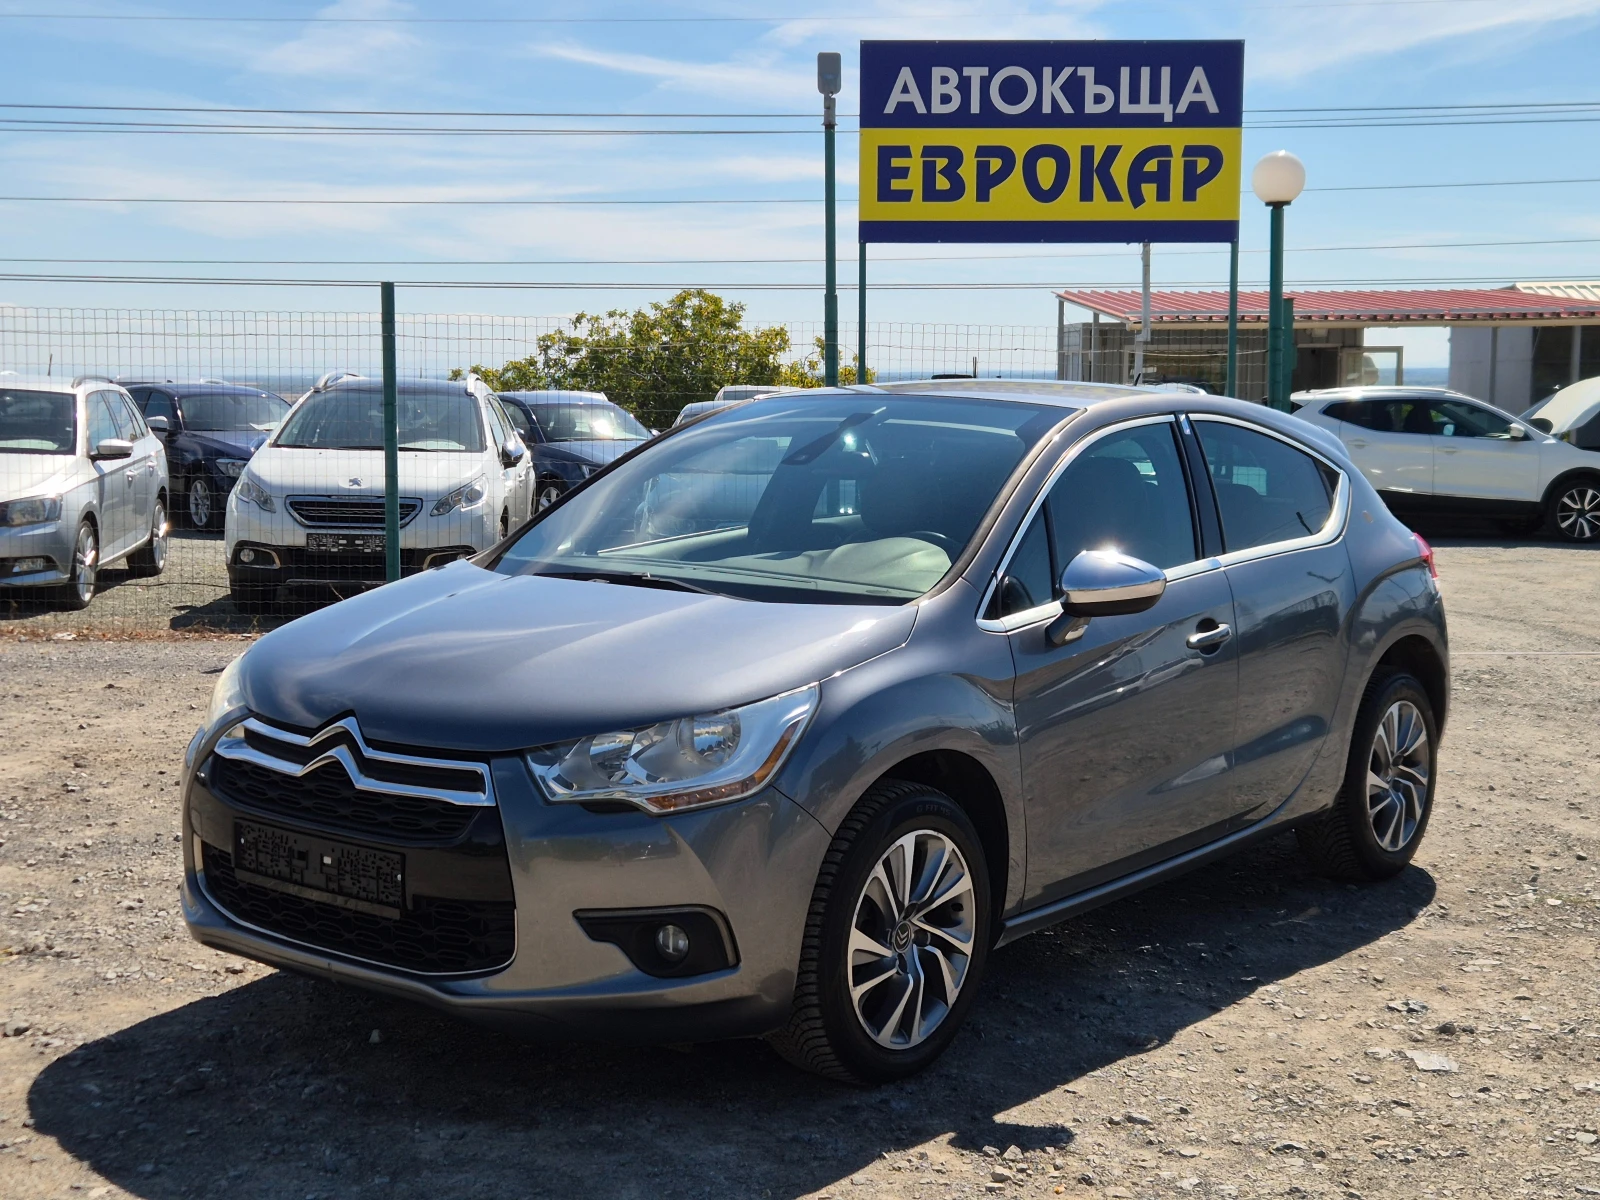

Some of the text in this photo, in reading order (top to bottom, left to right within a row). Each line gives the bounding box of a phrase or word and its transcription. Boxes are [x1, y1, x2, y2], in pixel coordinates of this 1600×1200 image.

[883, 65, 1220, 122] АВТОКЪЩА
[876, 143, 1224, 210] ЕВРОКАР
[925, 803, 939, 812] FIT
